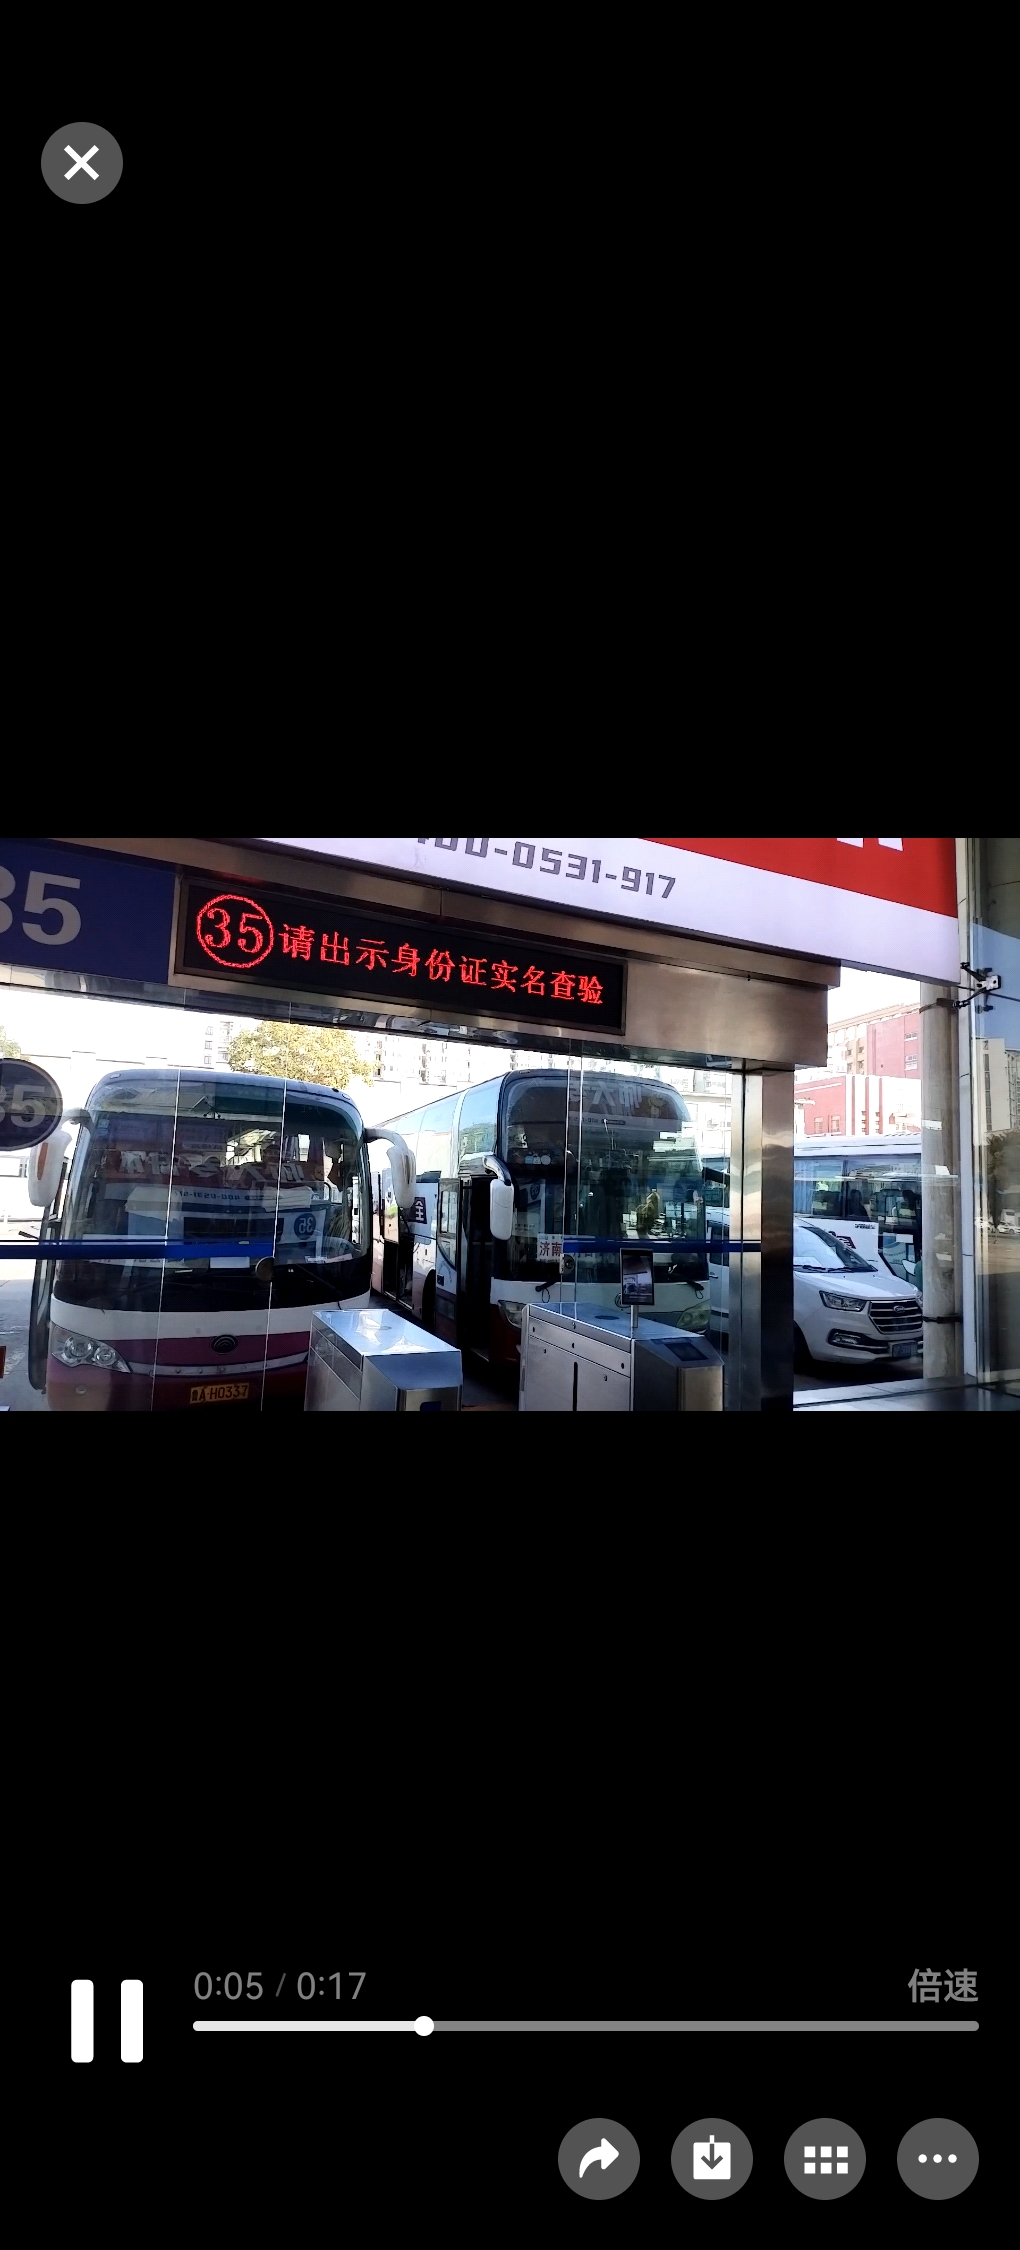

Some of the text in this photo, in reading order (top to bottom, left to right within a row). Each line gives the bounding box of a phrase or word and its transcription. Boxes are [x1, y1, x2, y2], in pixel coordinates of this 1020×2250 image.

[418, 838, 676, 899] 0-0531-917
[279, 923, 604, 1005] 请出示身份证实名查验
[0, 1084, 46, 1128] 5
